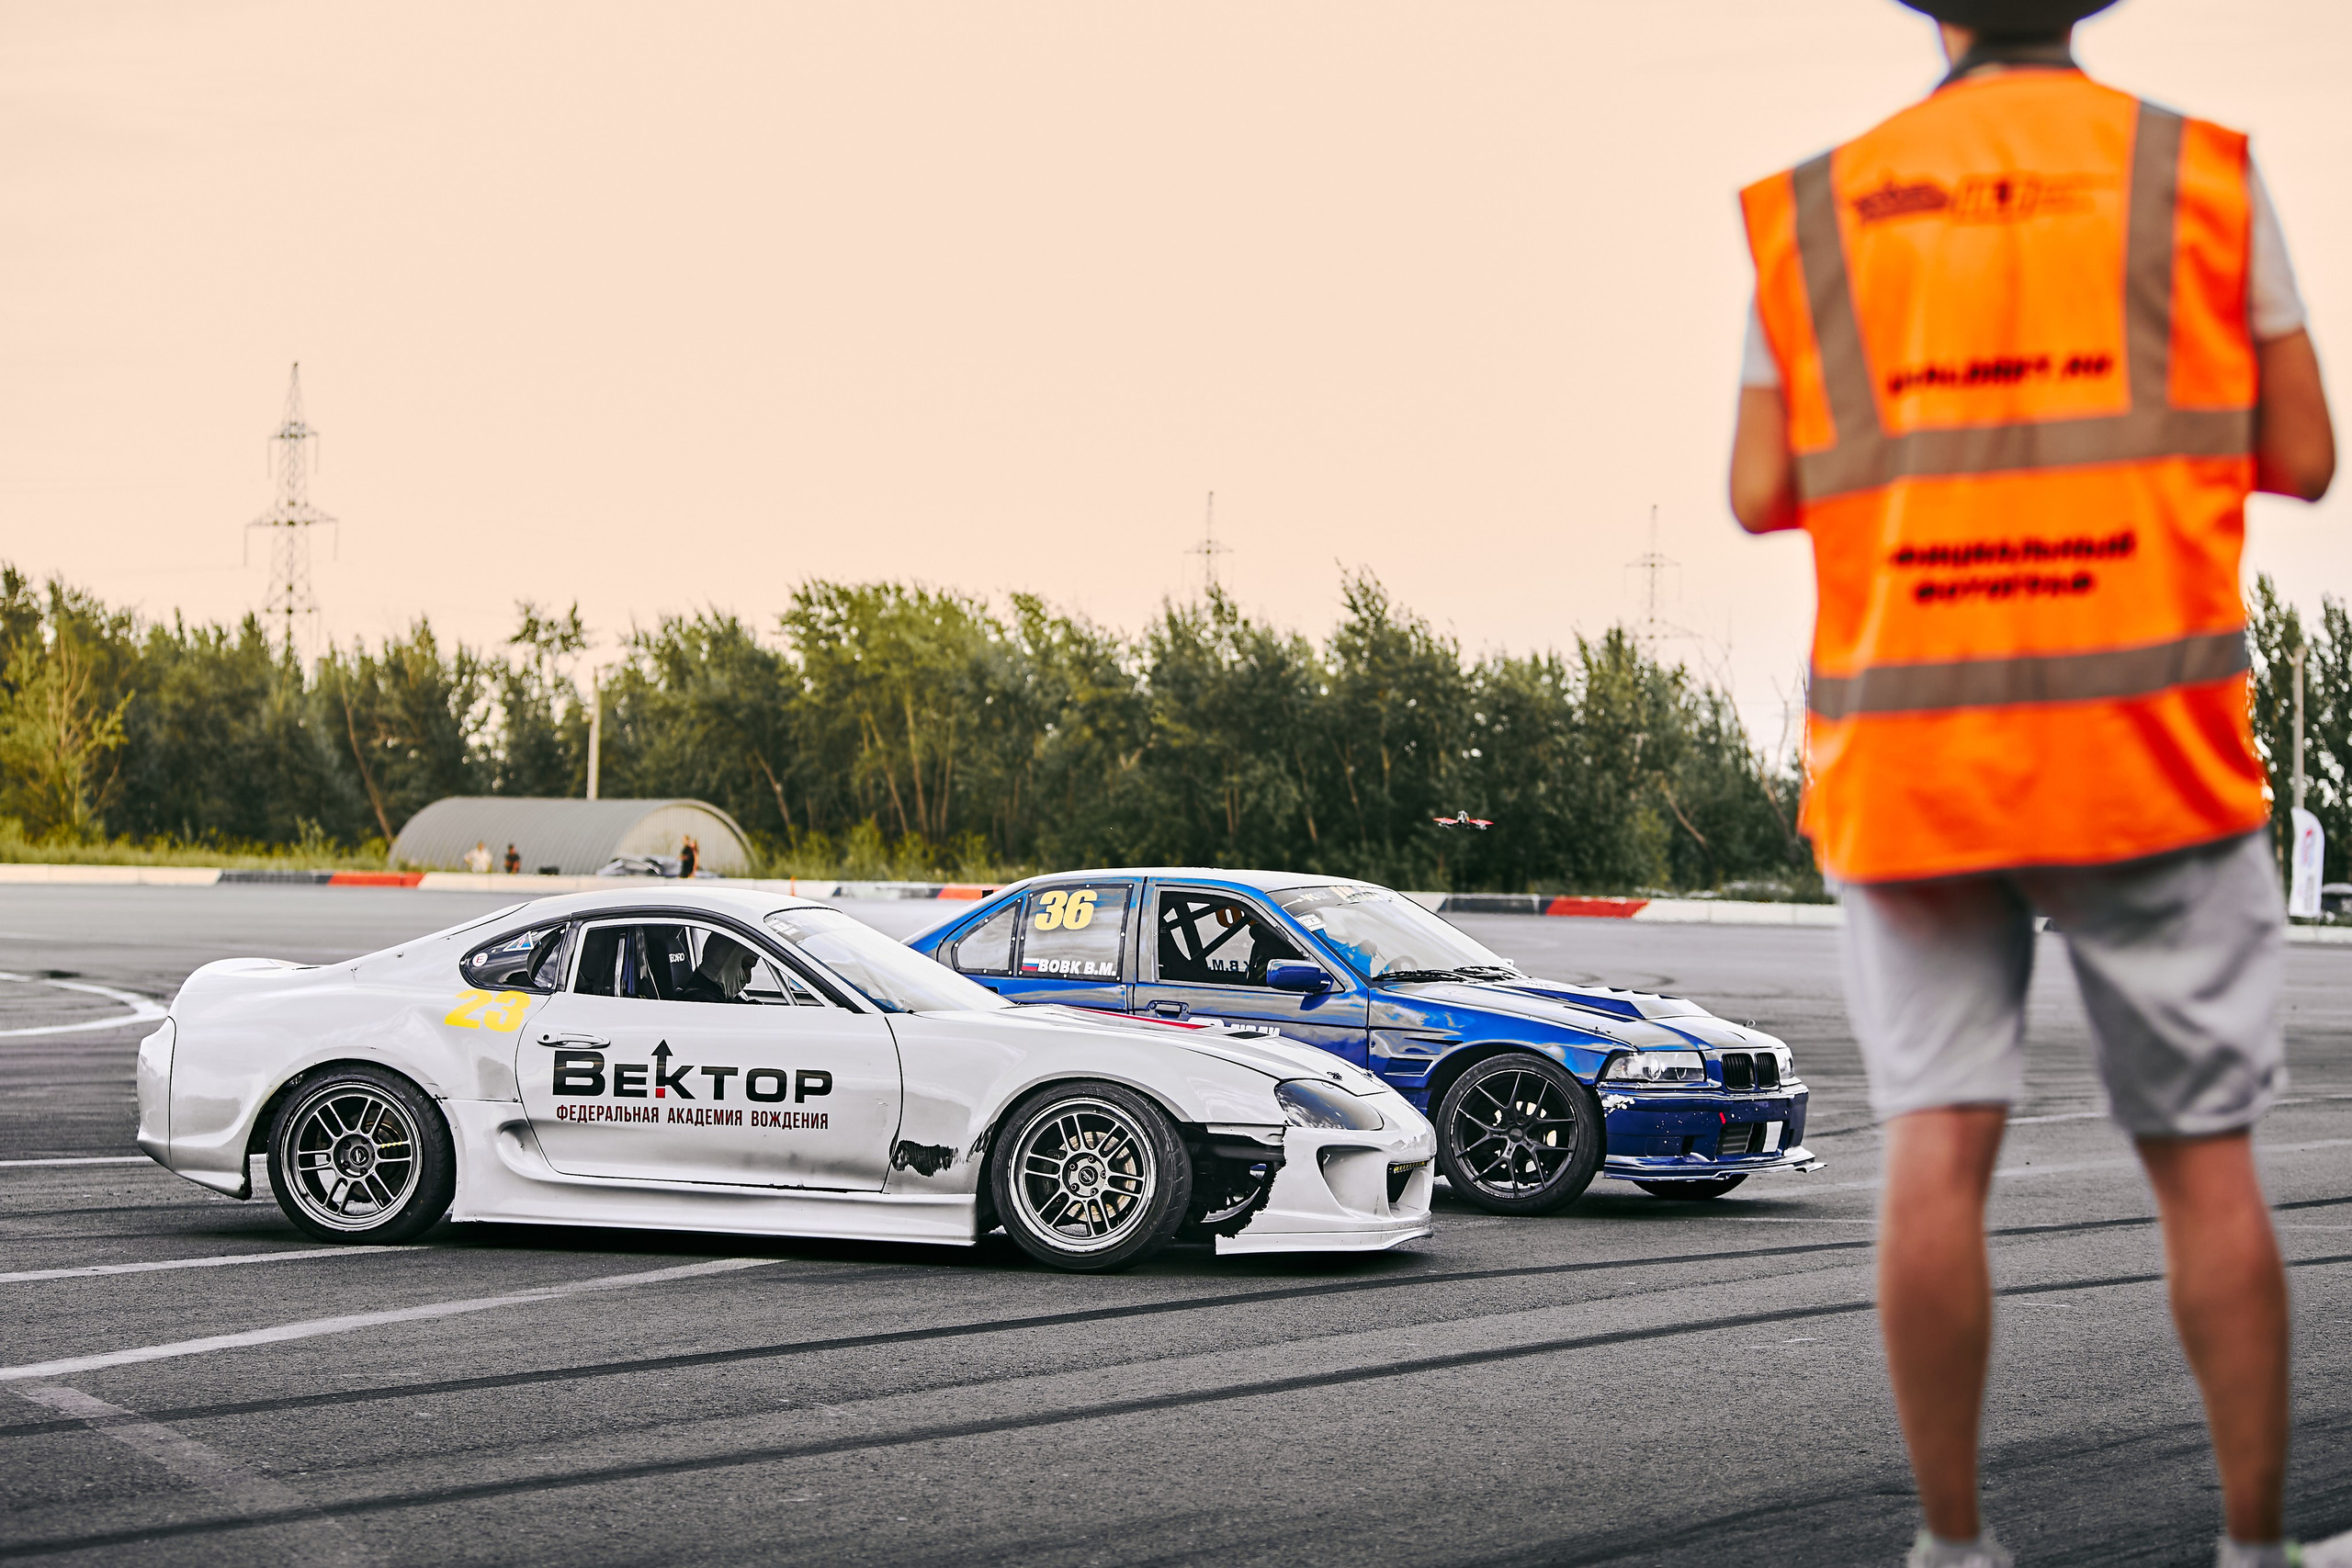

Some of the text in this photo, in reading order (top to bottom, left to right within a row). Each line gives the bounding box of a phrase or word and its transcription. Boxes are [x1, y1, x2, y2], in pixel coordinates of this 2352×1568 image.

[1035, 889, 1098, 931] 36
[444, 988, 532, 1033] 23
[556, 1104, 830, 1131] ФЕДЕРАЛЬНАЯ АКАДЕМИЯ ВОЖДЕНИЯ
